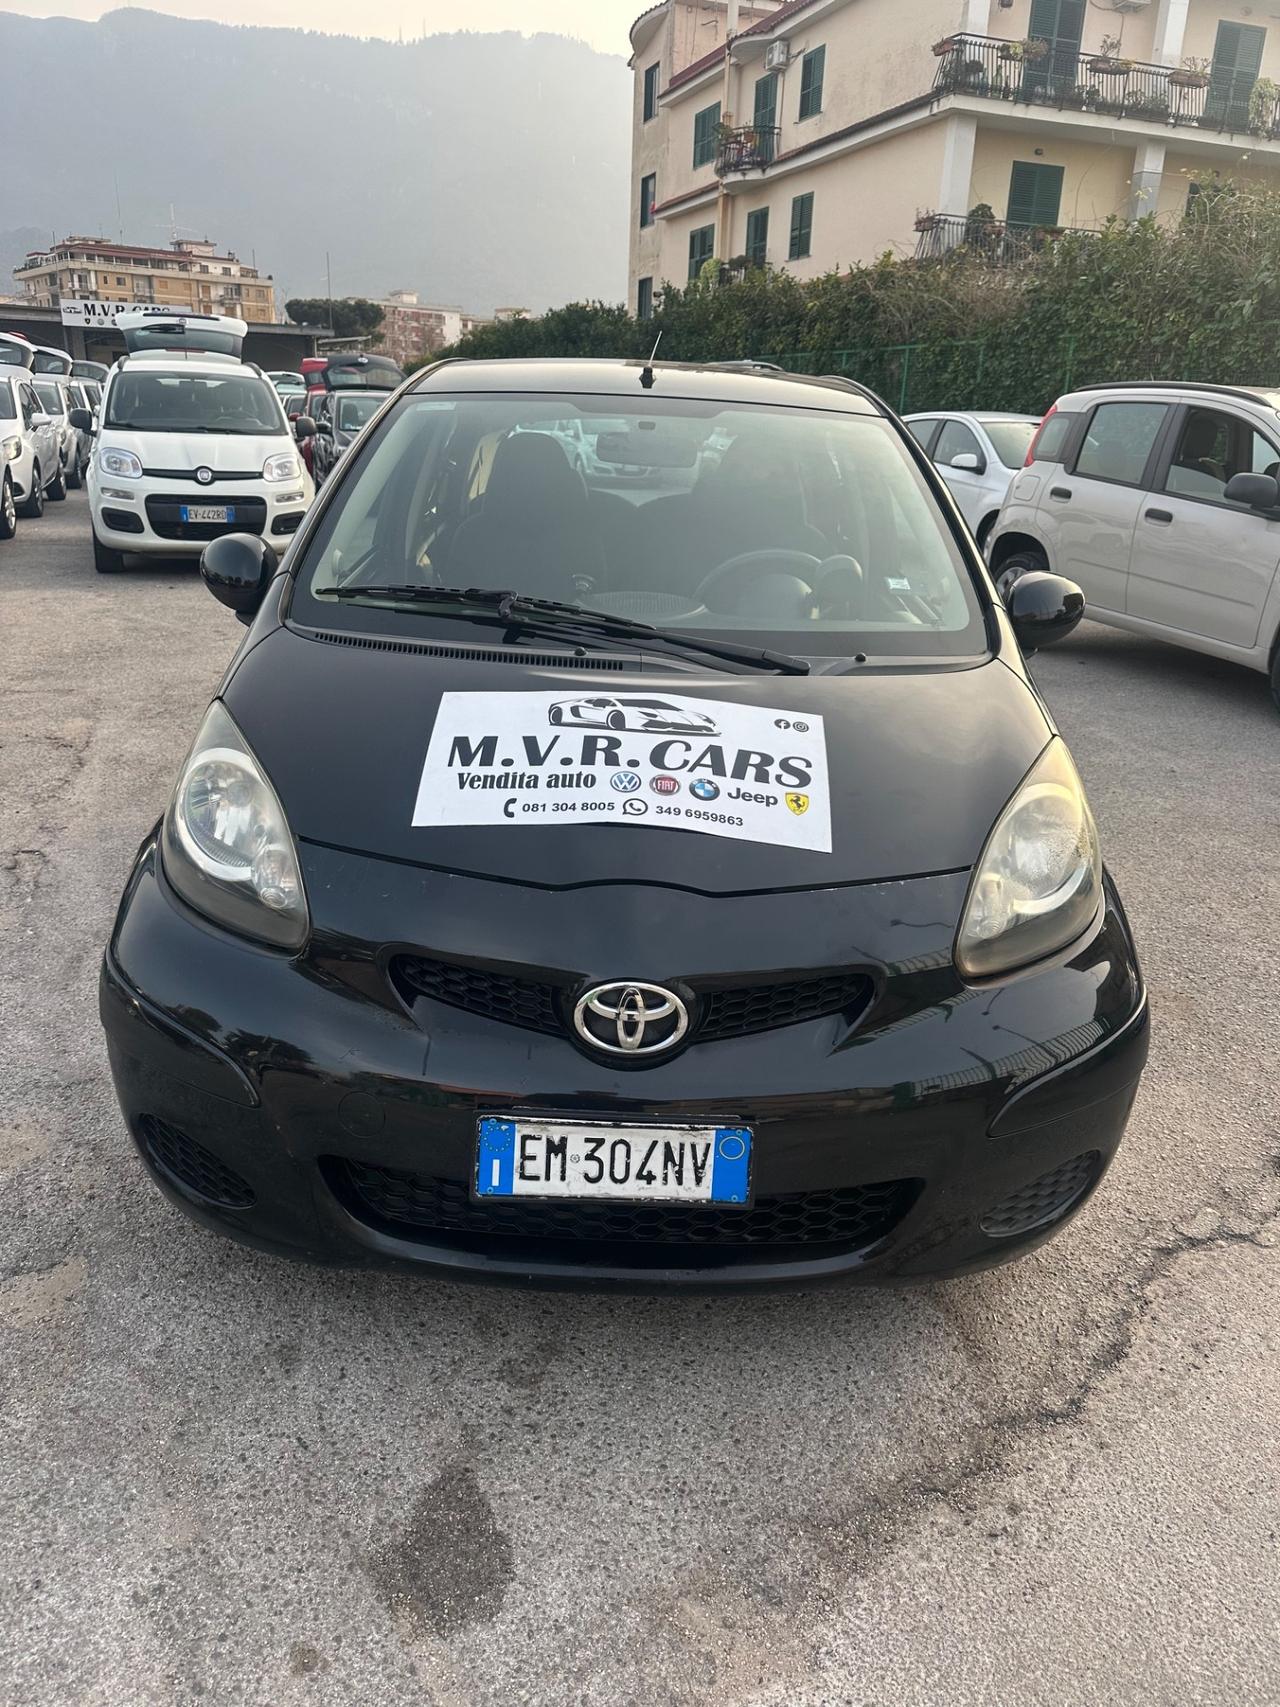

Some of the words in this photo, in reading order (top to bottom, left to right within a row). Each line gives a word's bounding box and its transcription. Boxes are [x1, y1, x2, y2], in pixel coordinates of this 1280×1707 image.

[447, 735, 640, 768] M.V.R.
[649, 739, 813, 788] CARS
[457, 771, 539, 790] Vendita
[546, 771, 597, 789] auto
[657, 780, 675, 791] FIAT
[727, 787, 779, 807] Jeep
[522, 803, 546, 813] 081
[552, 802, 577, 812] 304
[581, 802, 615, 811] 8005
[655, 805, 682, 816] 349
[685, 808, 744, 827] 6959863
